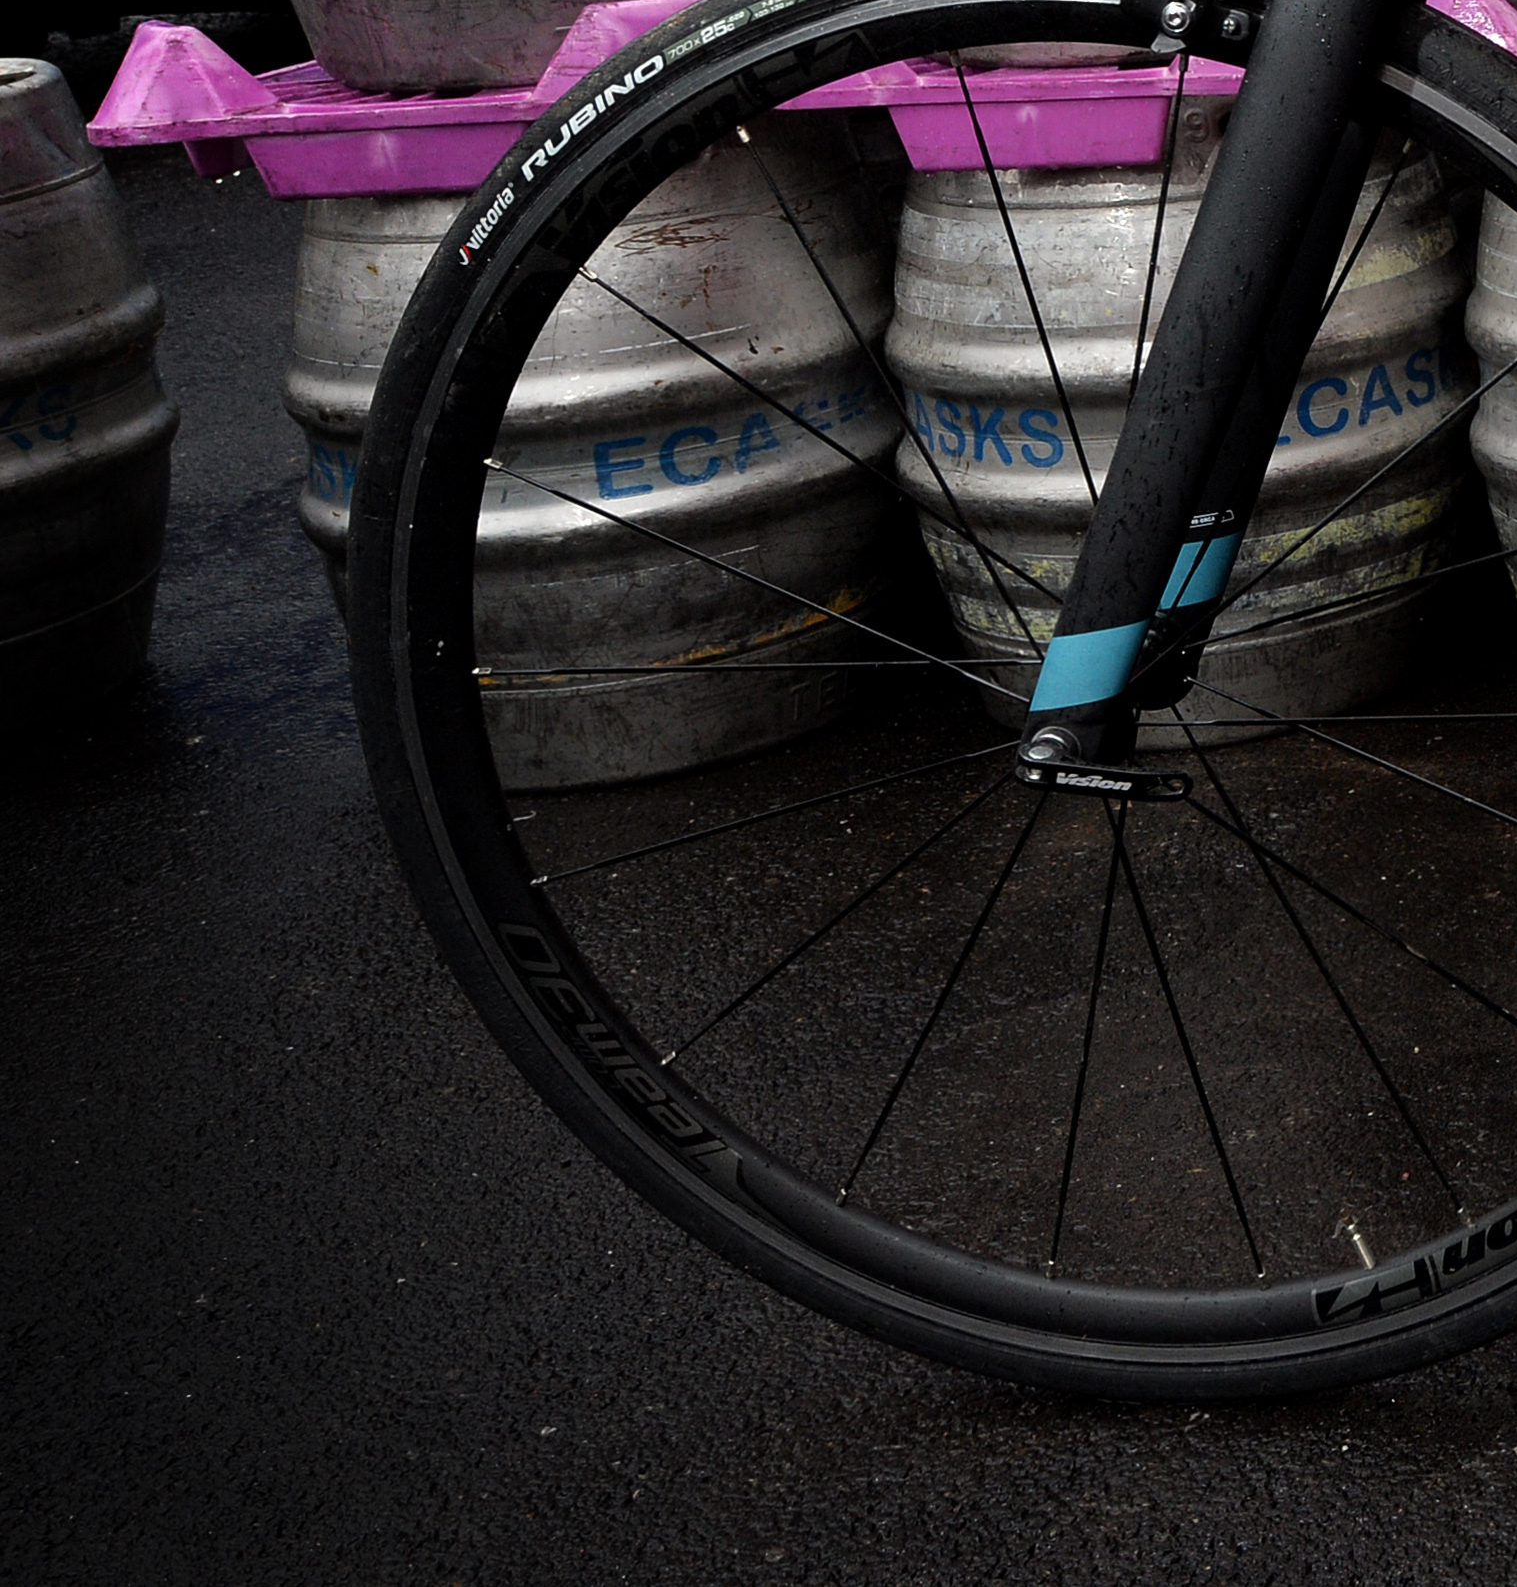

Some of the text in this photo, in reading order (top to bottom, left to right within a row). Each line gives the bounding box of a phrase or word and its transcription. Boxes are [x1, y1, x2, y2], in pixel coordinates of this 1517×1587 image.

[520, 54, 665, 182] RUBINO
[467, 187, 516, 252] vittoria
[1054, 770, 1135, 794] Vision
